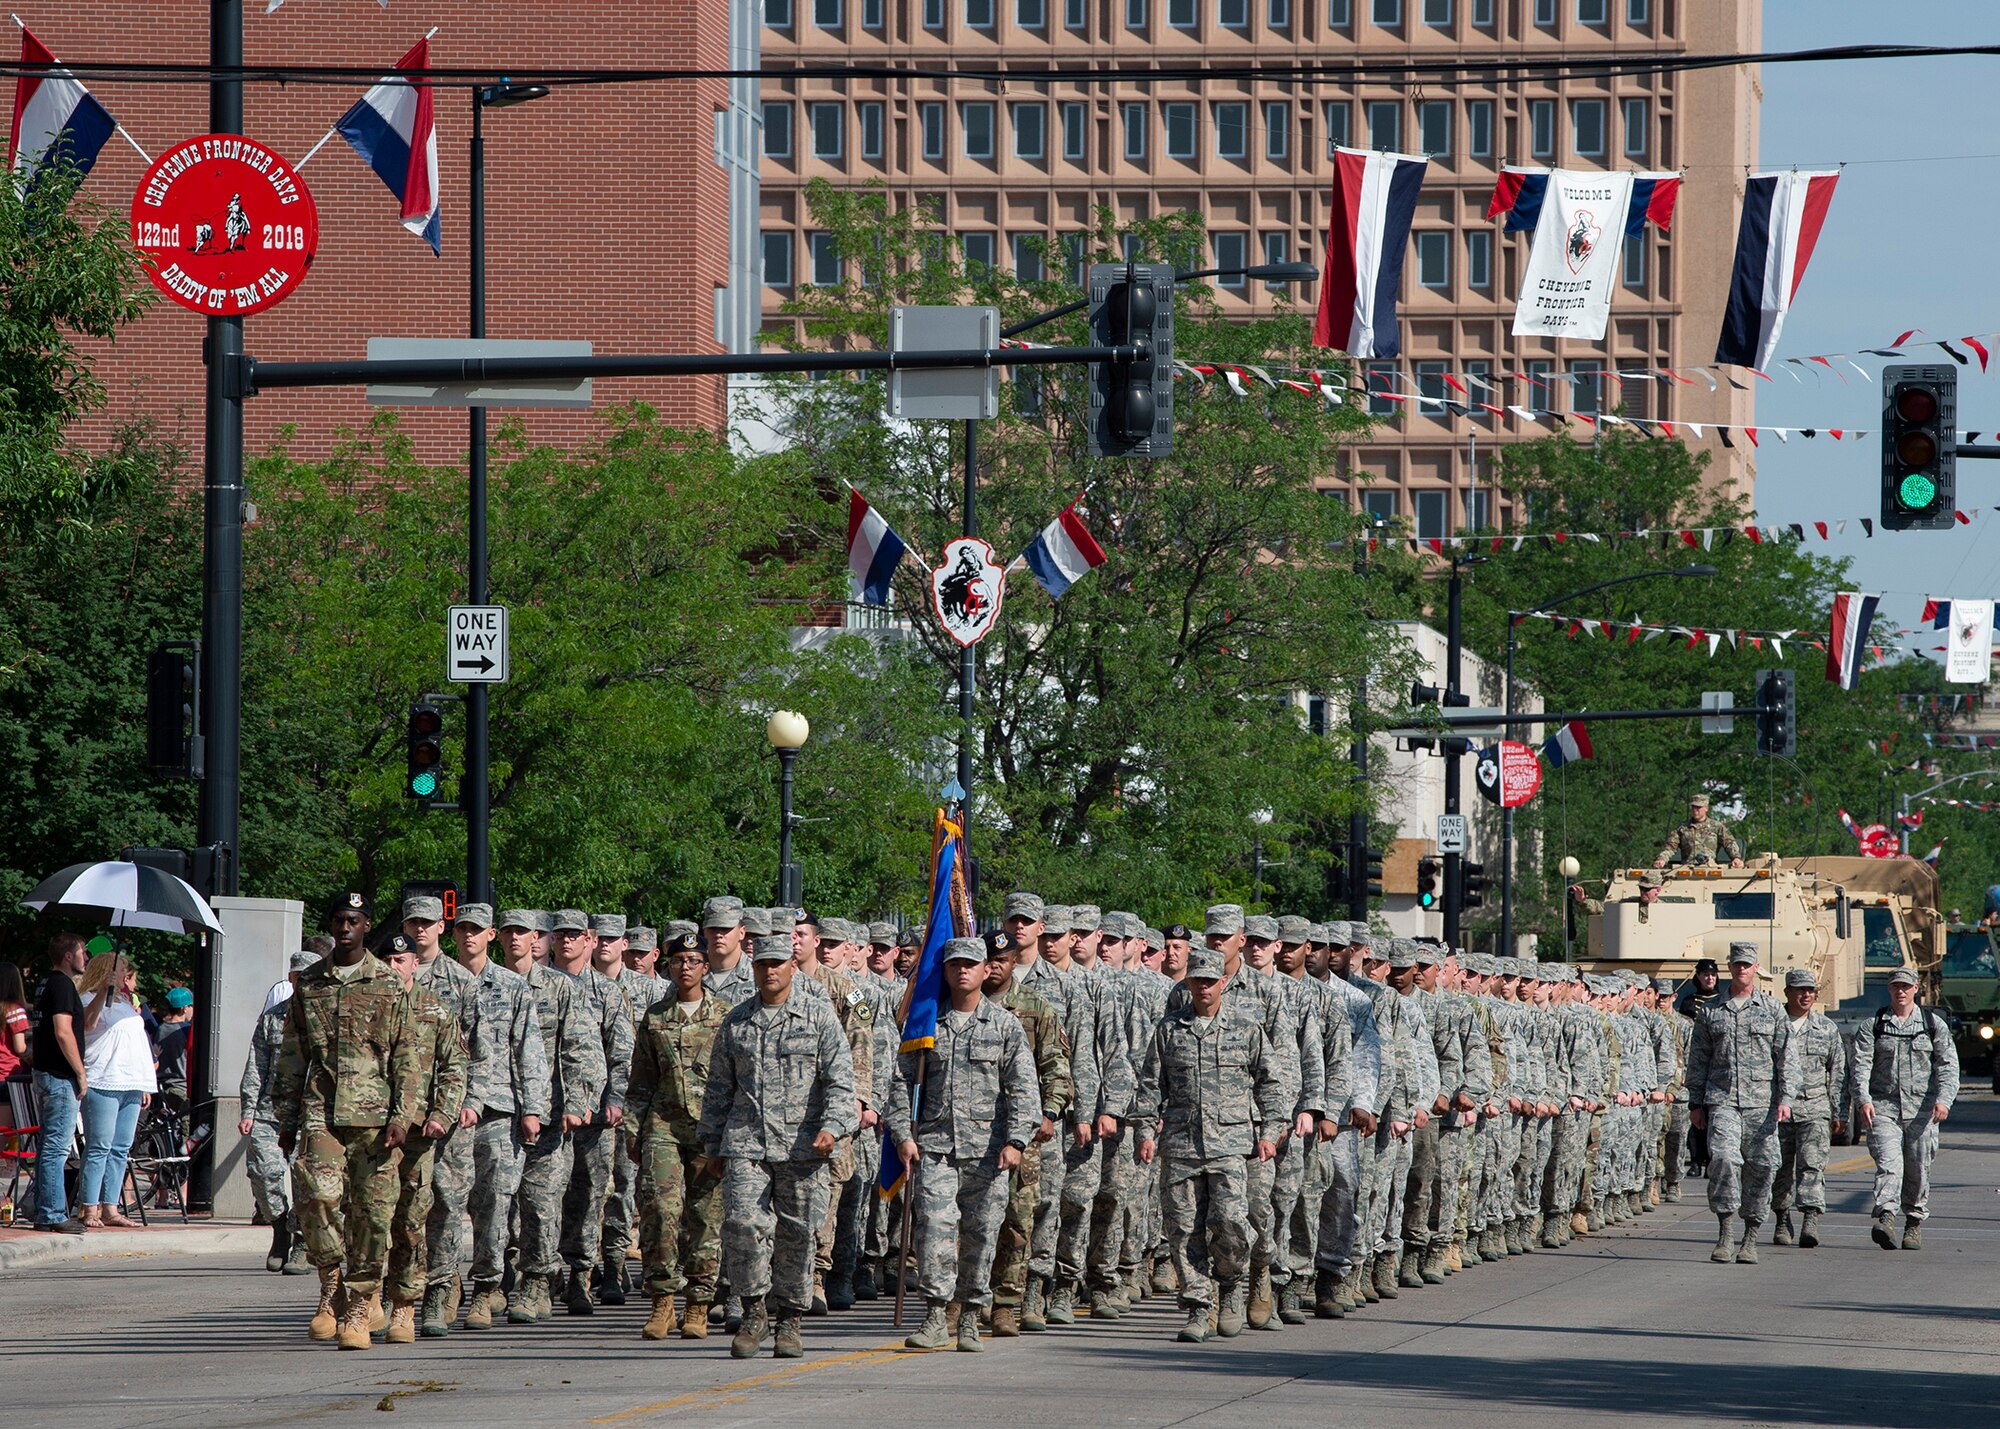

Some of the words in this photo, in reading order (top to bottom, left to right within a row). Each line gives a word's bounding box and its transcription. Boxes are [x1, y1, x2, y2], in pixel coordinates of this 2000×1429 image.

[143, 143, 203, 207] CHEYENNE
[203, 139, 274, 174] FRONTIER
[266, 166, 300, 205] DAYS
[1564, 187, 1612, 200] WELCOME
[137, 221, 181, 248] 122nd
[262, 224, 305, 251] 2018
[160, 262, 209, 304] DADDY
[208, 289, 226, 309] OF
[230, 283, 262, 308] 'EM
[258, 267, 290, 297] ALL
[1542, 315, 1569, 326] DAYS
[456, 612, 497, 630] ONE
[456, 633, 497, 651] WAY
[1504, 772, 1537, 784] FRONTIER
[1441, 817, 1462, 828] ONE
[1441, 828, 1462, 838] WAY
